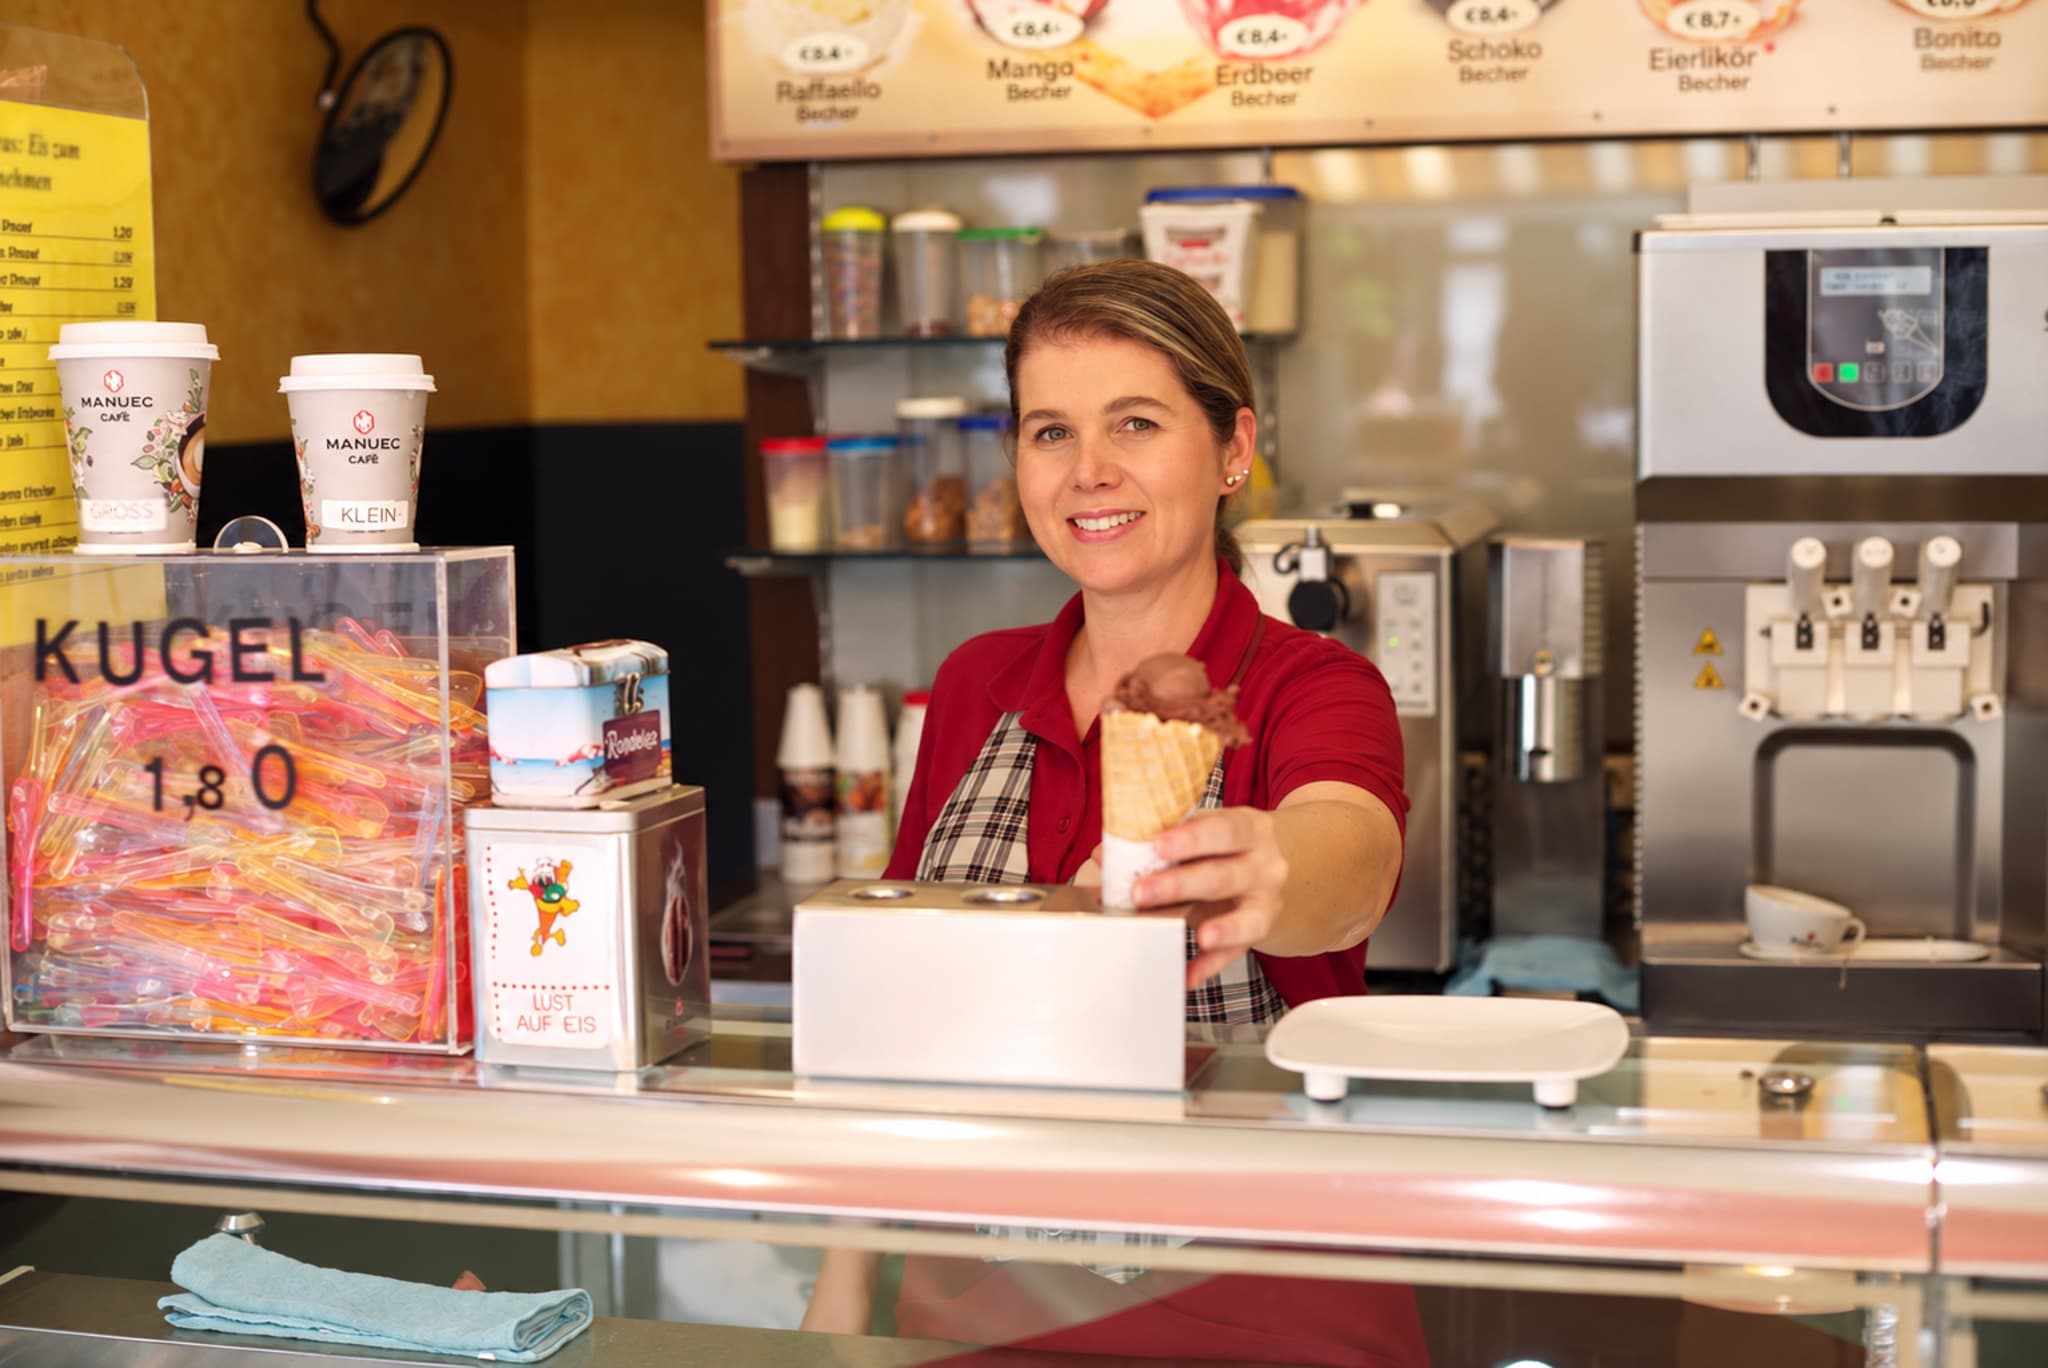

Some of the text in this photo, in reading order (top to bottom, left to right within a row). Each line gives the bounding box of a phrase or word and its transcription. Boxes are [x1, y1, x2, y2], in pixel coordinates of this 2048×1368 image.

[1912, 26, 2003, 50] Bonito
[1447, 38, 1544, 63] Schoko
[1649, 44, 1759, 72] Eierlikör
[986, 57, 1076, 83] Mango
[1919, 53, 1998, 72] Becher
[1214, 61, 1315, 87] Erdbeer
[1458, 65, 1531, 84] Becher
[1677, 74, 1752, 93] Becher
[1006, 83, 1074, 103] Becher
[1231, 89, 1299, 108] Becher
[795, 104, 861, 124] Becher
[80, 396, 154, 409] MANUEC
[325, 437, 401, 451] MANUEC
[341, 507, 398, 524] KLEIN
[34, 616, 326, 687] KUGEL
[532, 993, 575, 1012] LUST
[516, 1014, 597, 1034] AUF EIS
